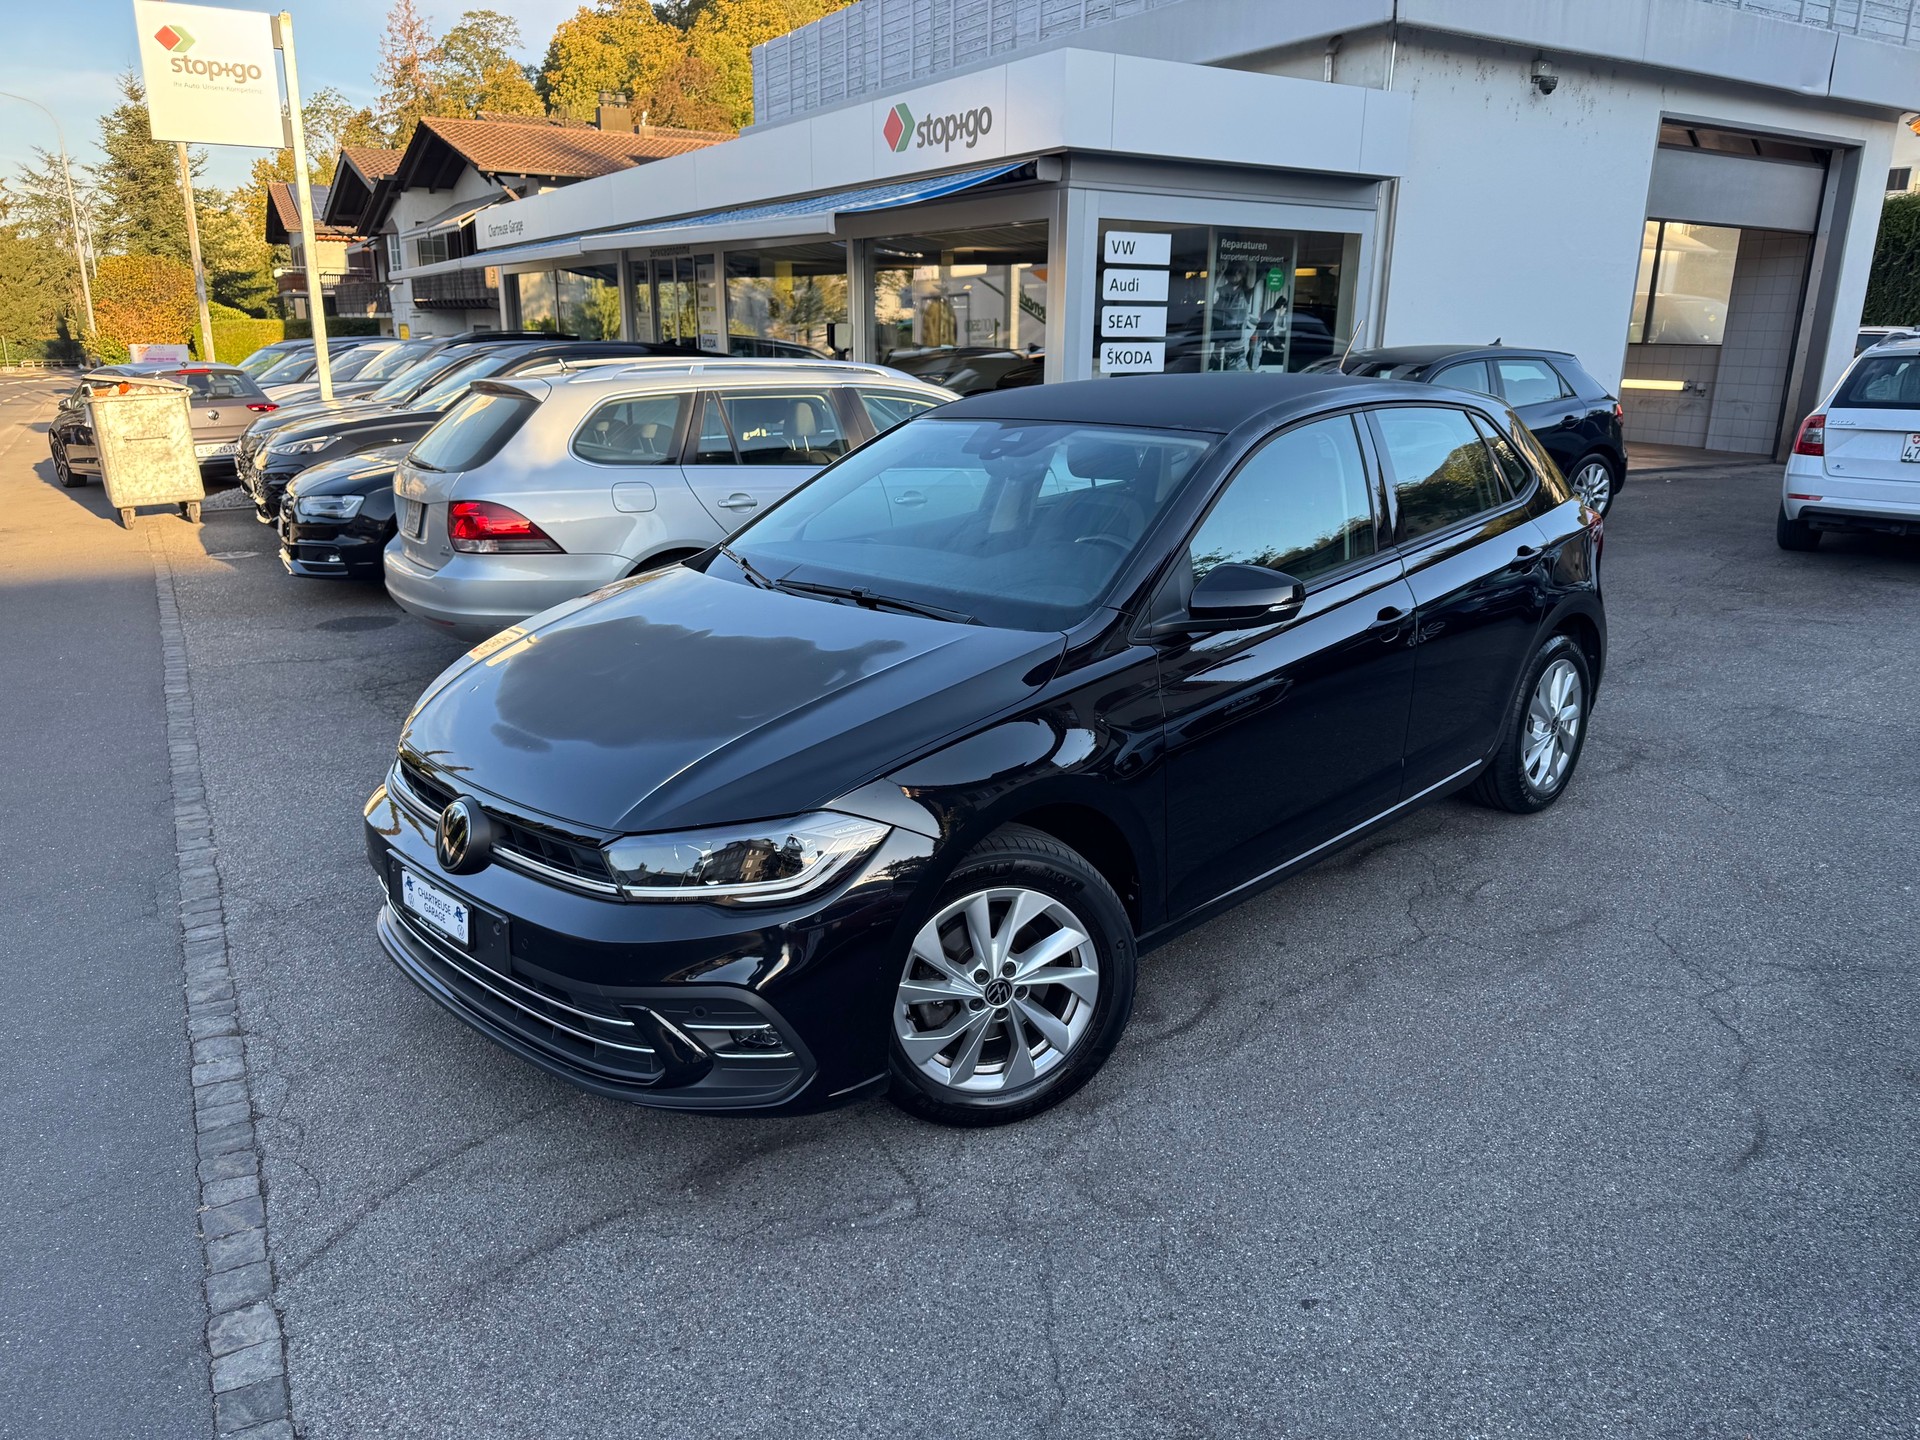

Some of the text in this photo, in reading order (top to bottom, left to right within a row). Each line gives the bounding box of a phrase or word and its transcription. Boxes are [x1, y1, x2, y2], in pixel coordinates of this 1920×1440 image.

[171, 55, 262, 84] stop+go
[917, 106, 992, 153] stop+go
[508, 219, 524, 236] Garage
[1111, 240, 1136, 255] VW
[1221, 239, 1268, 251] Reparaturen
[1220, 252, 1285, 264] kompetent und preiswert
[1109, 278, 1139, 292] Audi
[1108, 315, 1141, 329] SEAT
[1107, 347, 1153, 365] ŠKODA
[418, 887, 452, 916] CHARTREUSE
[424, 902, 446, 924] GARAGE
